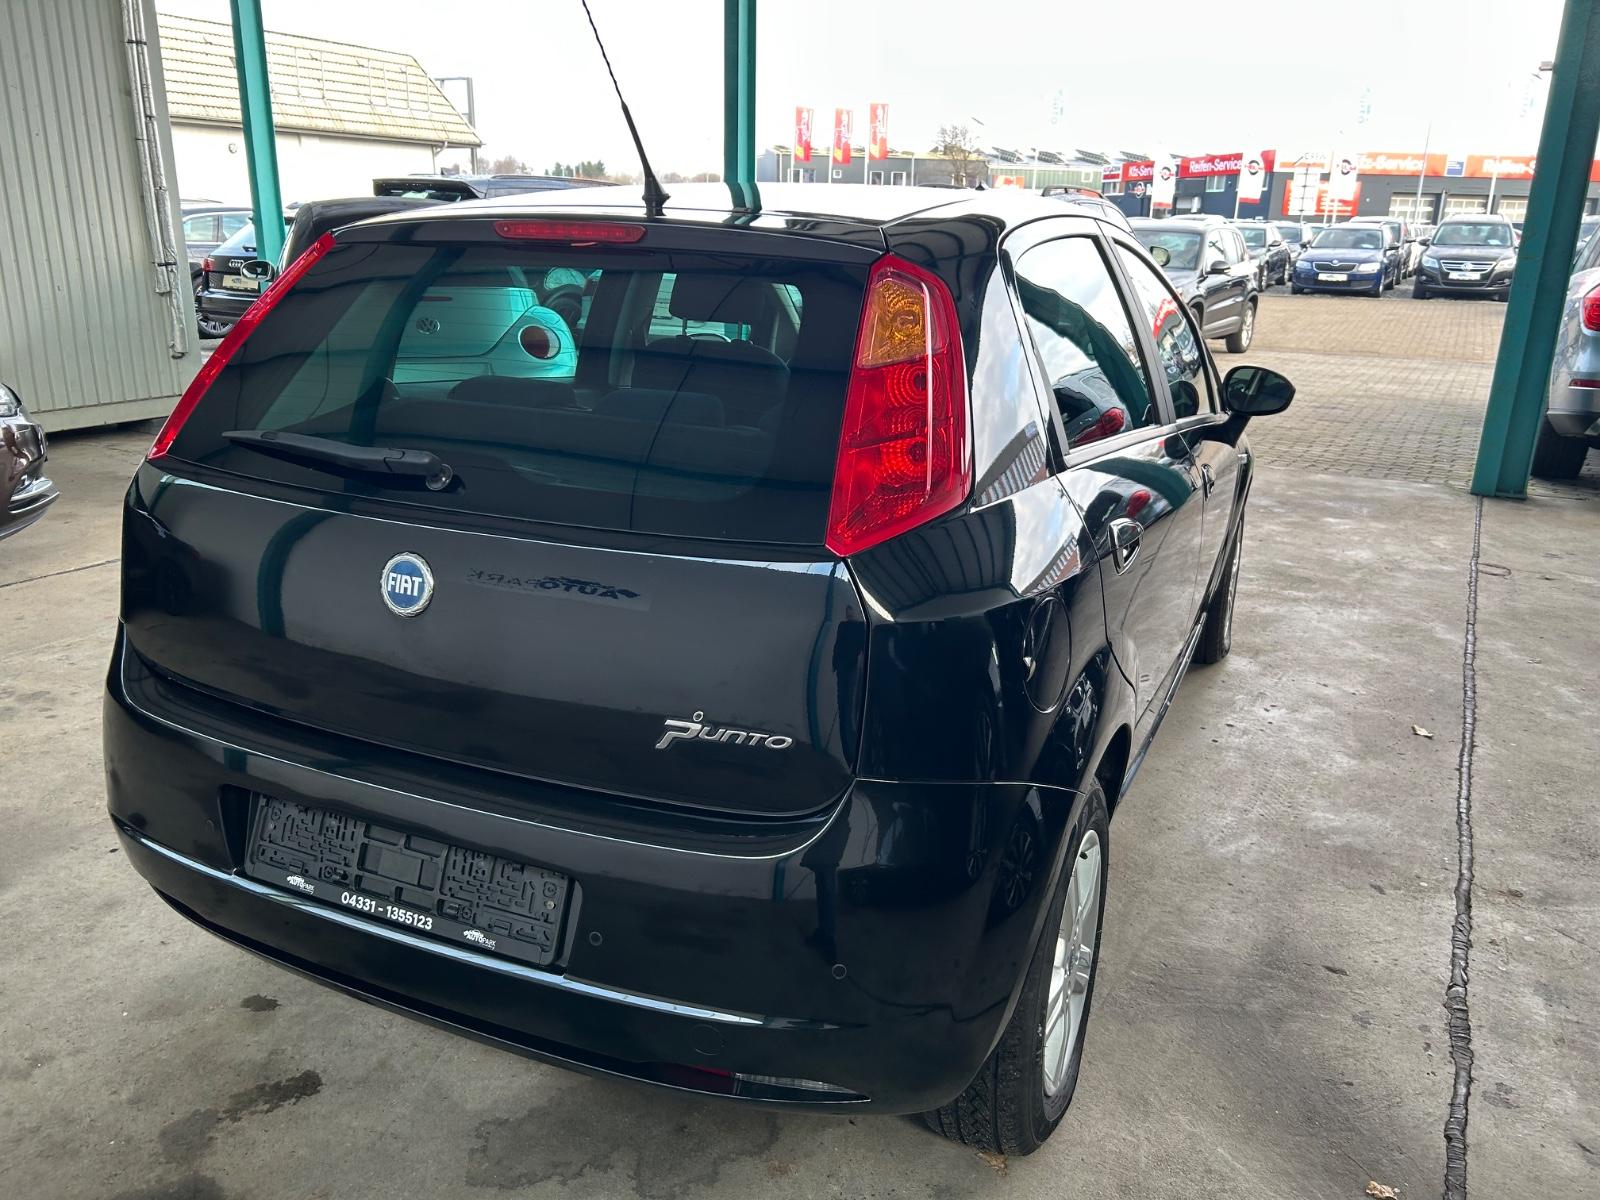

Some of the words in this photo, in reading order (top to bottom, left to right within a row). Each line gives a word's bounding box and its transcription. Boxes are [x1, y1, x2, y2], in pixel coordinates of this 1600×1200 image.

[1189, 158, 1242, 174] Reifen-Service
[387, 572, 423, 597] FIAT
[341, 891, 376, 913] 04331
[386, 905, 433, 930] 1355123
